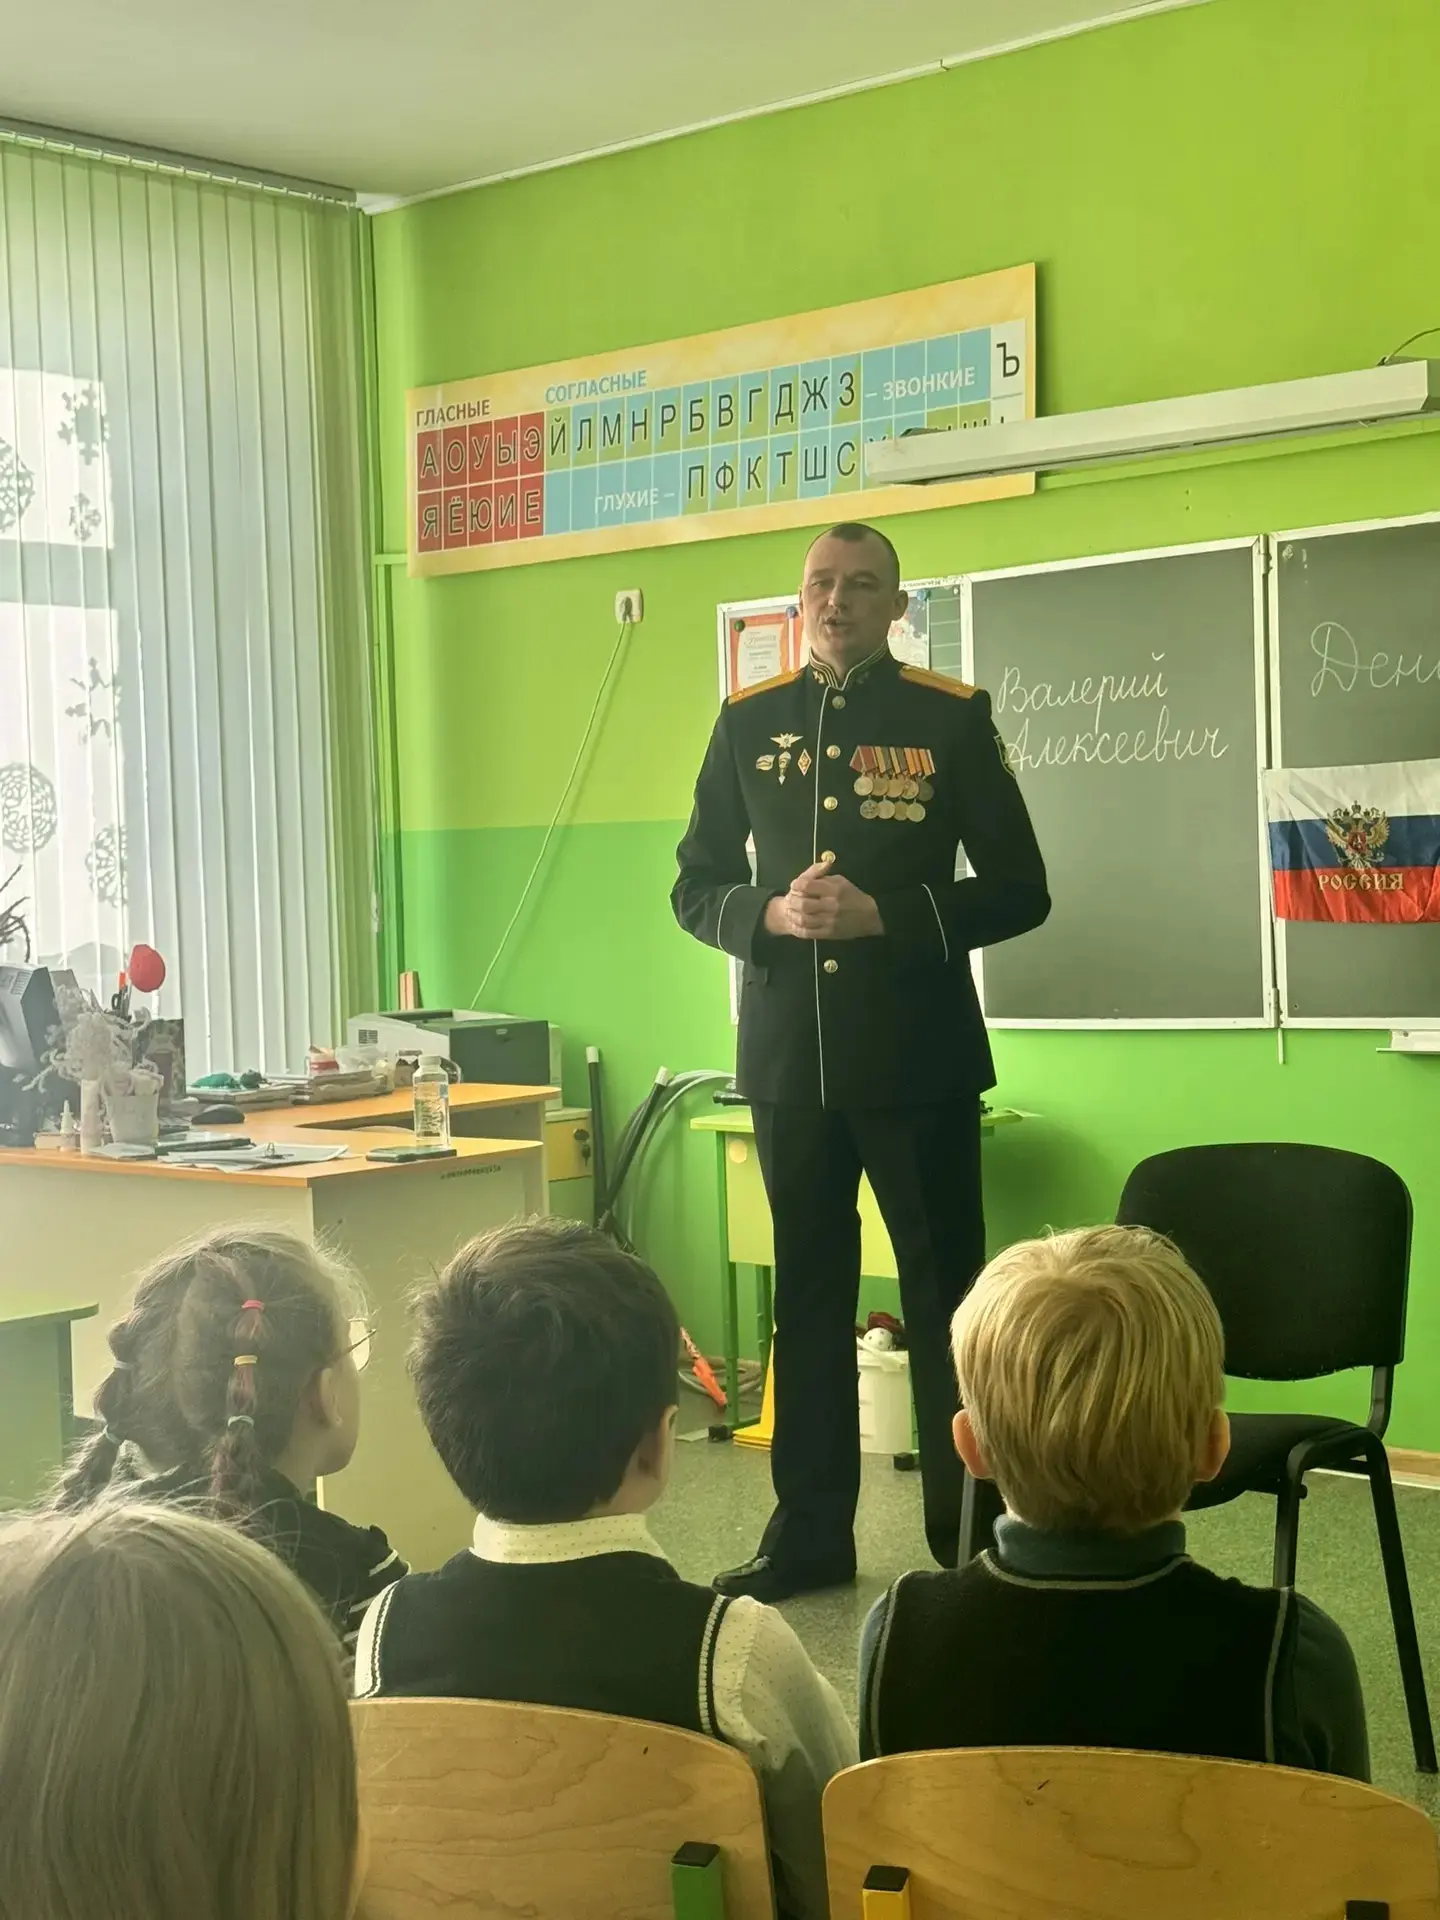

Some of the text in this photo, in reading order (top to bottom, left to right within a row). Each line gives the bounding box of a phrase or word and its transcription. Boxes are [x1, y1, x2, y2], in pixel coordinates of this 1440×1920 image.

[996, 342, 1021, 379] Ъ
[545, 370, 647, 404] СОГЛАСНЫЕ
[882, 366, 975, 402] ЗВОНКИЕ
[416, 399, 491, 427] ГЛАСНЫЕ
[594, 488, 659, 515] ГЛУХИЕ
[996, 651, 1169, 735] Валерий
[1005, 704, 1230, 772] Алексеевич
[1317, 872, 1405, 892] РОССИЯ
